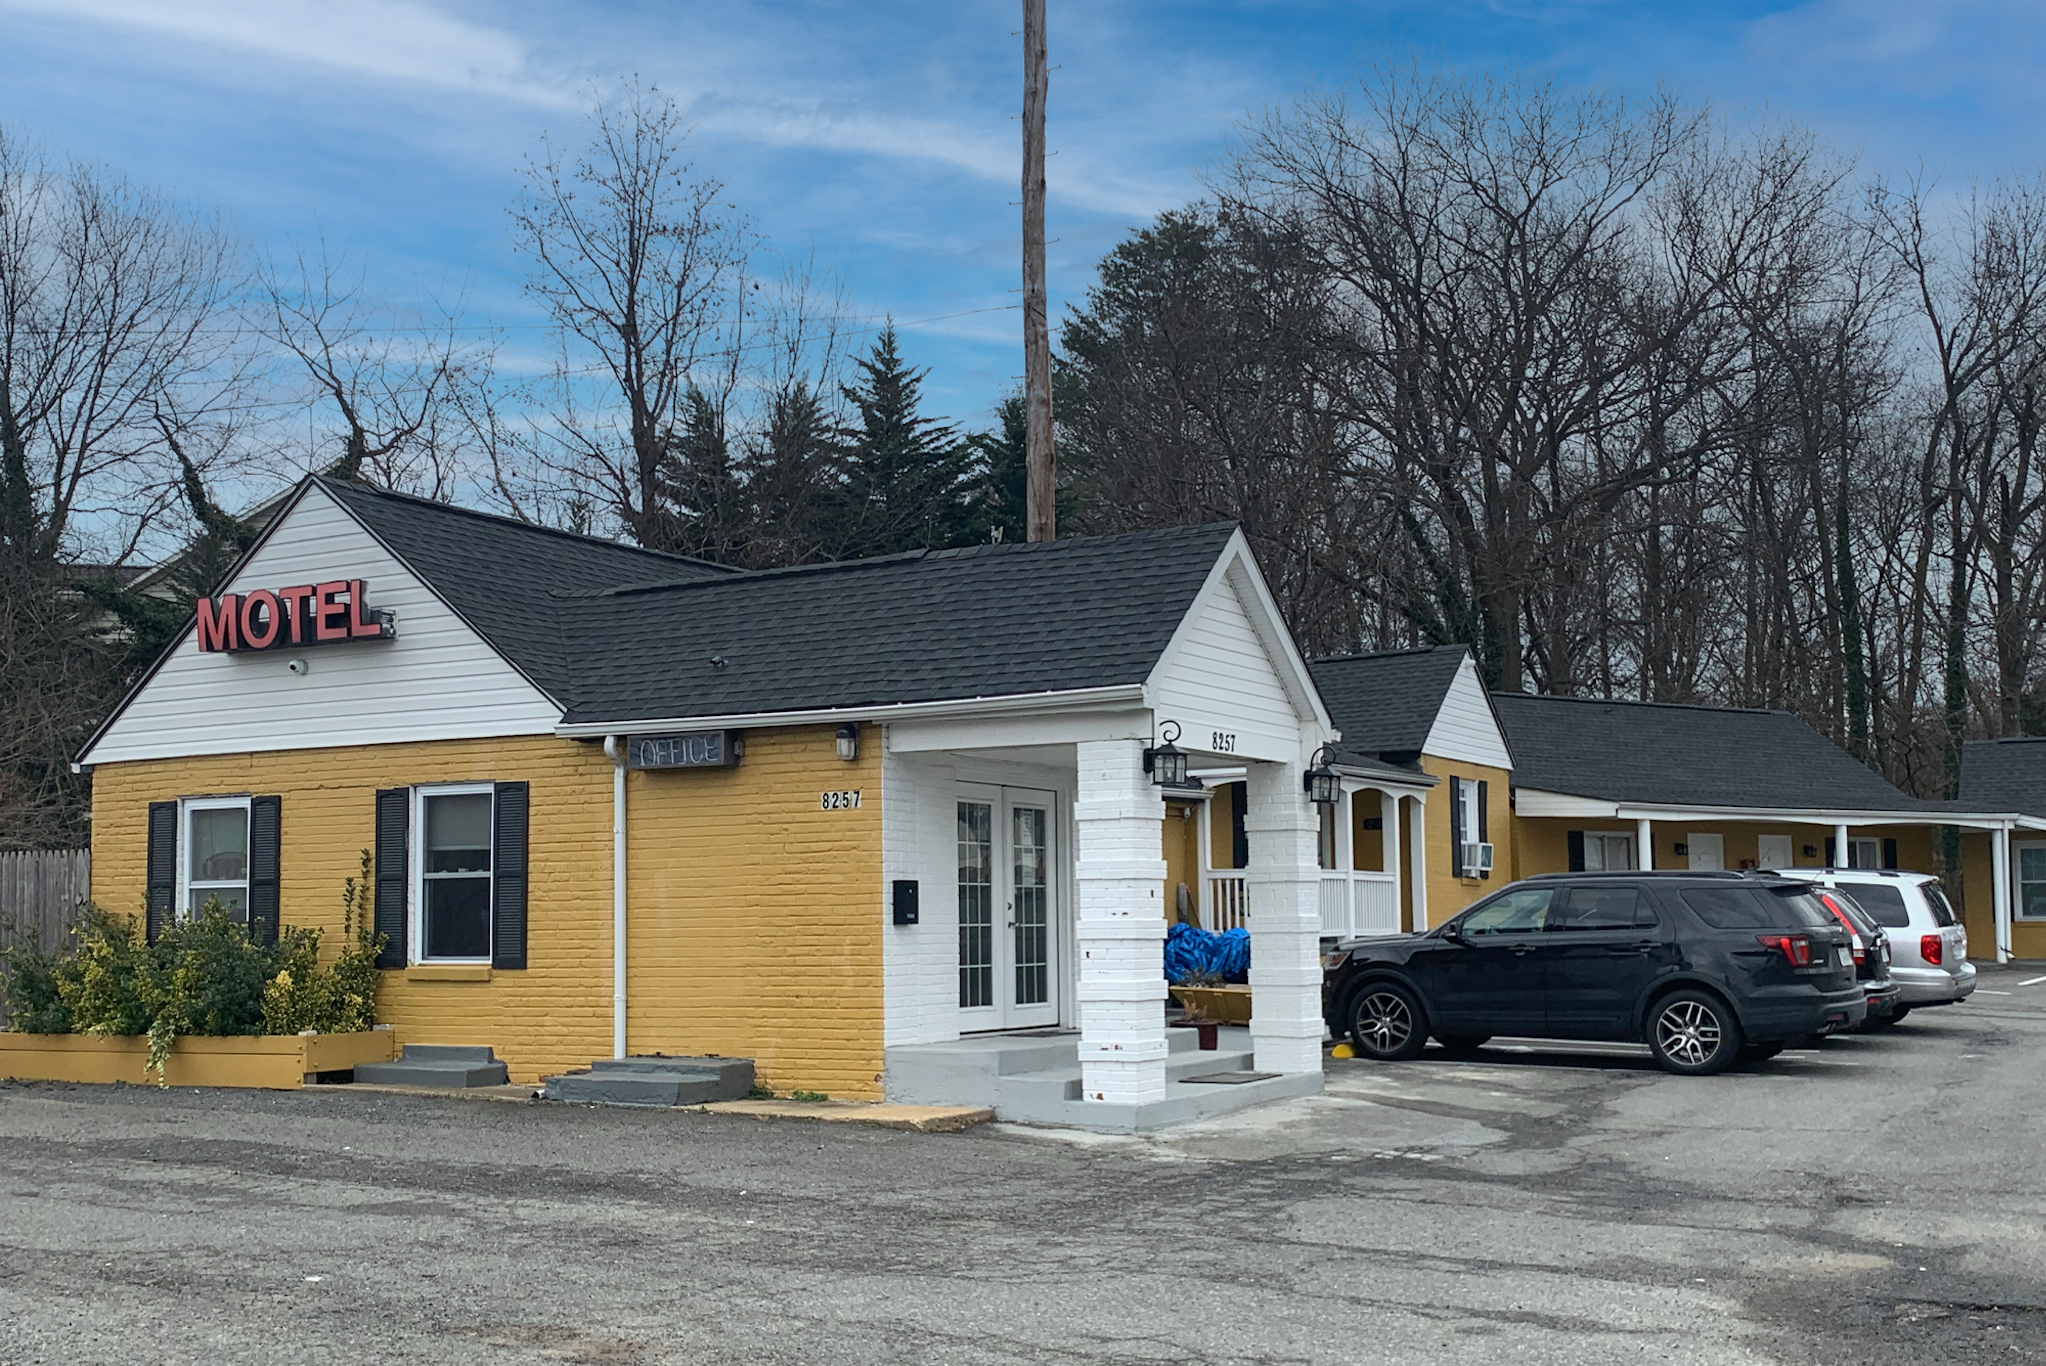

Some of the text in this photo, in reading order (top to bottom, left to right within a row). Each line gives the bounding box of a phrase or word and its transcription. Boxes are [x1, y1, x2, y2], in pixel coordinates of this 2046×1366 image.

[197, 579, 381, 652] MOTEL
[640, 736, 719, 766] OFFICE
[1212, 731, 1236, 752] 8257
[822, 791, 860, 809] 8257
